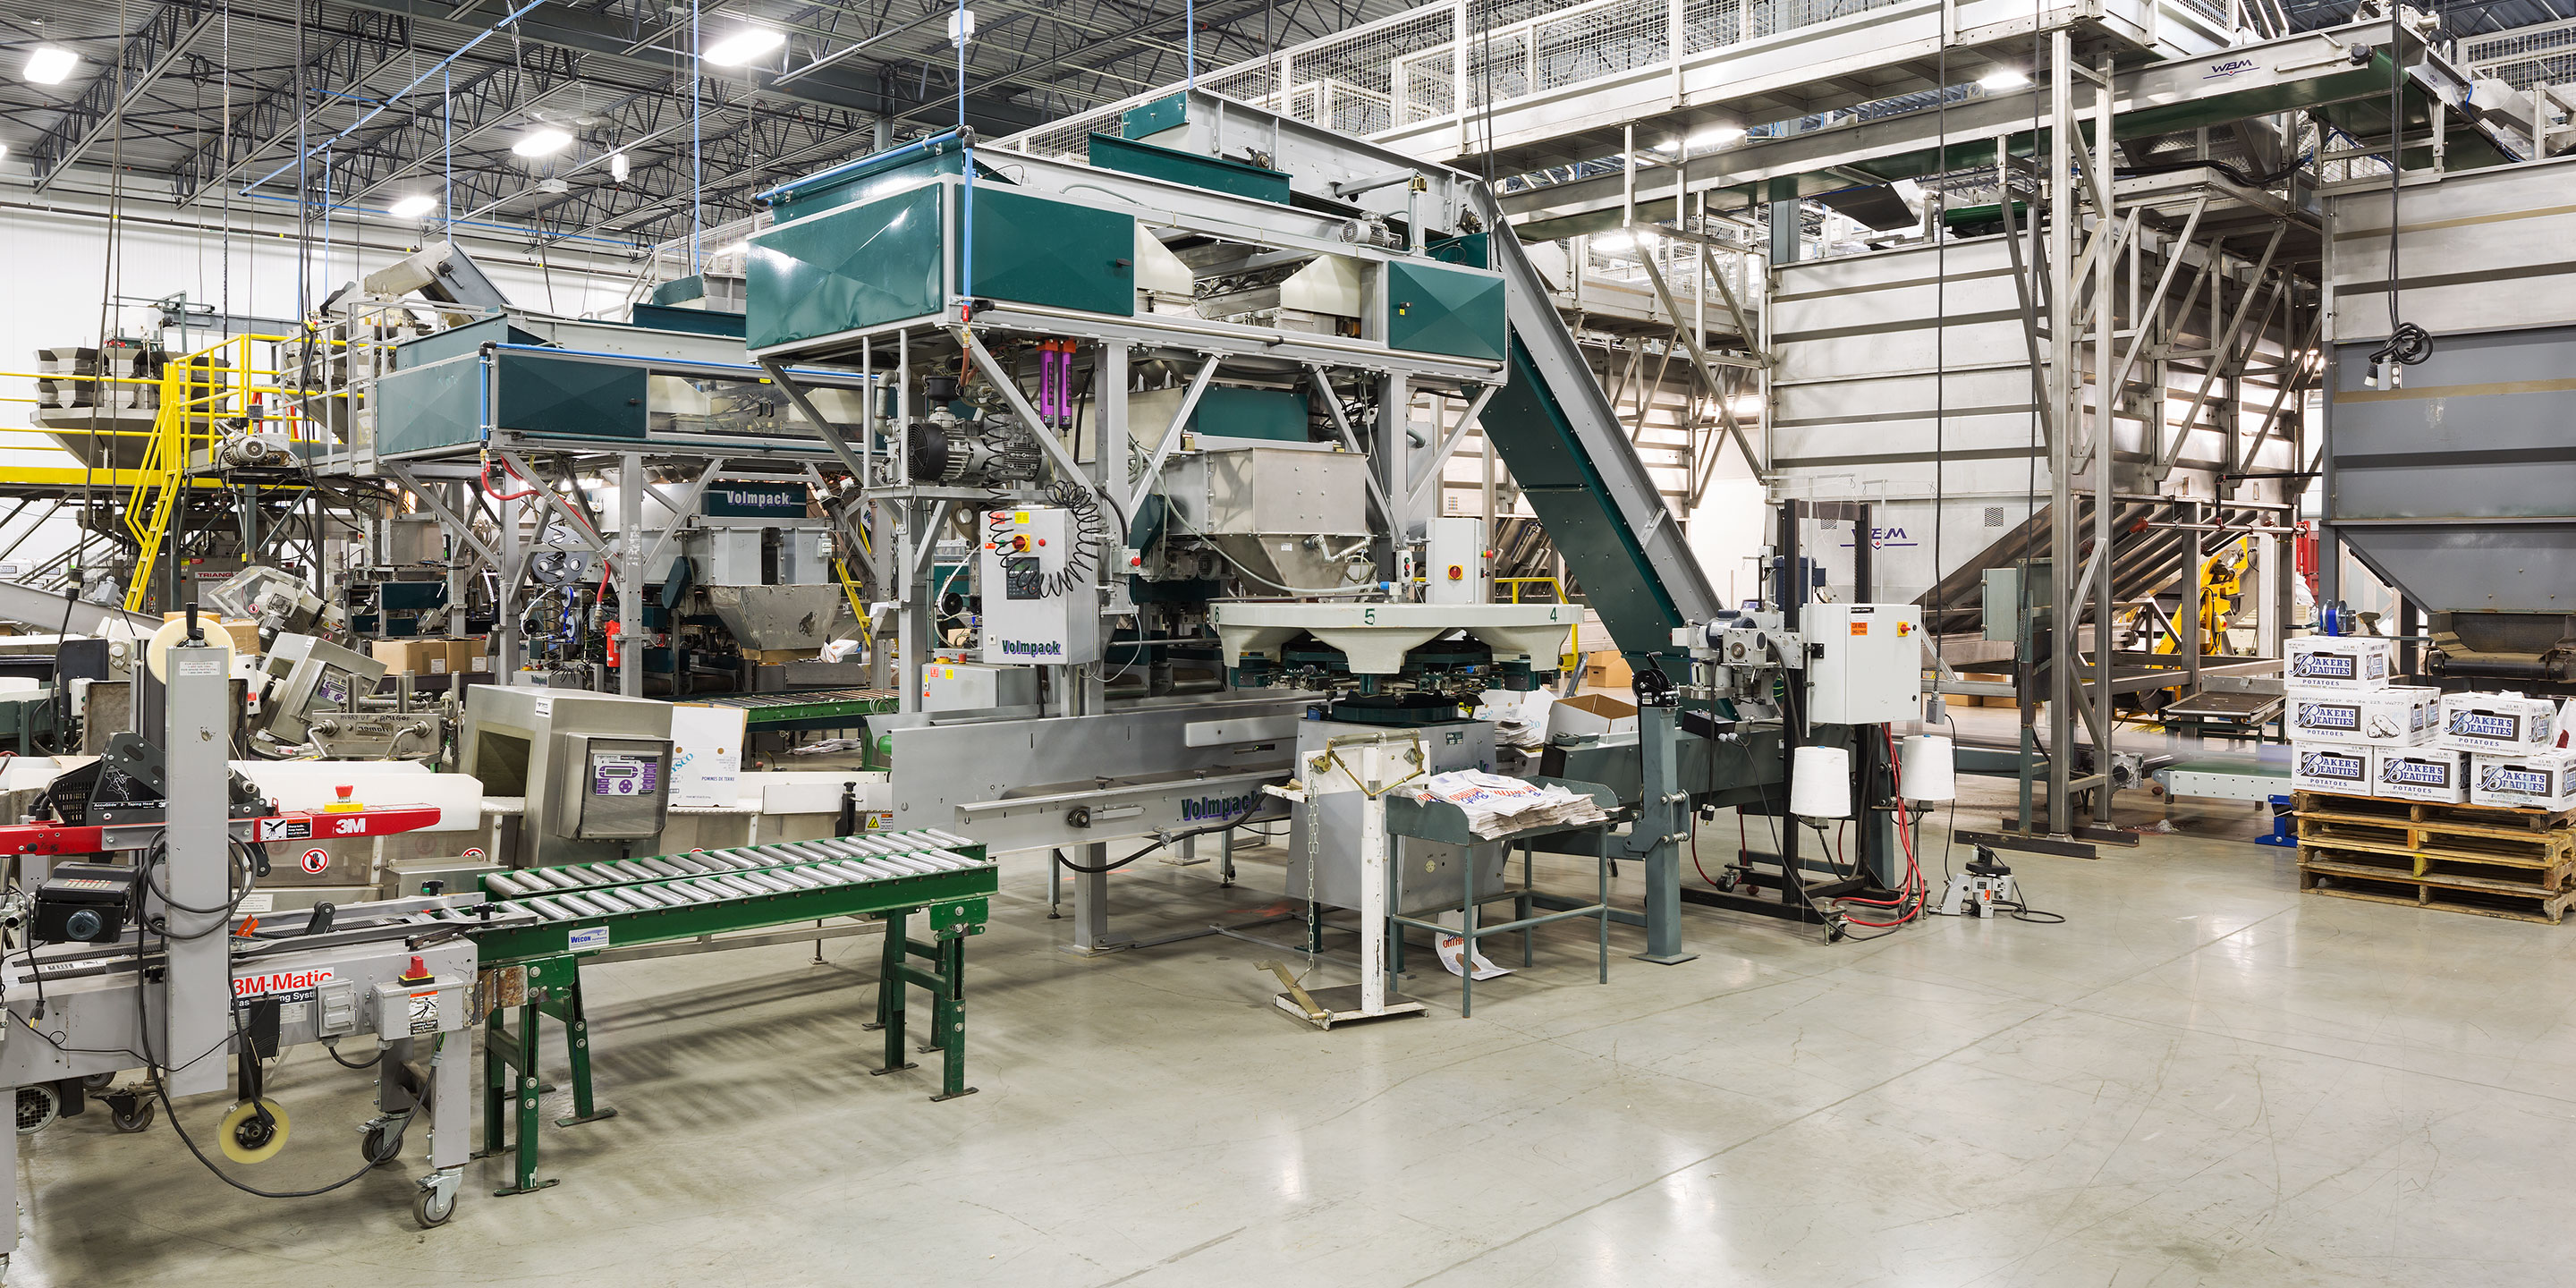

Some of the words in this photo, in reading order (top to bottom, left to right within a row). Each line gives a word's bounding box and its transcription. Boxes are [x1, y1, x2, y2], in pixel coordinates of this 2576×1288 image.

[2211, 59, 2253, 73] WBM
[726, 491, 791, 508] Volmpack
[1852, 528, 1907, 539] BM
[1215, 606, 1220, 623] 6
[1364, 608, 1376, 625] 5
[1550, 607, 1558, 623] 4
[1002, 640, 1062, 657] Volmpack
[2288, 653, 2350, 676] BAKER'S
[2293, 702, 2354, 727] BAKER'S
[2293, 710, 2354, 727] BEAUTIES
[2444, 710, 2512, 735] BAKER'S
[2458, 737, 2500, 746] POTATOES
[671, 753, 694, 775] YSCO
[2296, 752, 2358, 775] BAKER'S
[2378, 758, 2443, 783] BAKER'S
[2309, 778, 2348, 786] POTATOES
[2393, 784, 2432, 793] POTATOES
[335, 818, 366, 834] 3M
[570, 936, 591, 944] WECON
[233, 970, 332, 996] 3M-Matic
